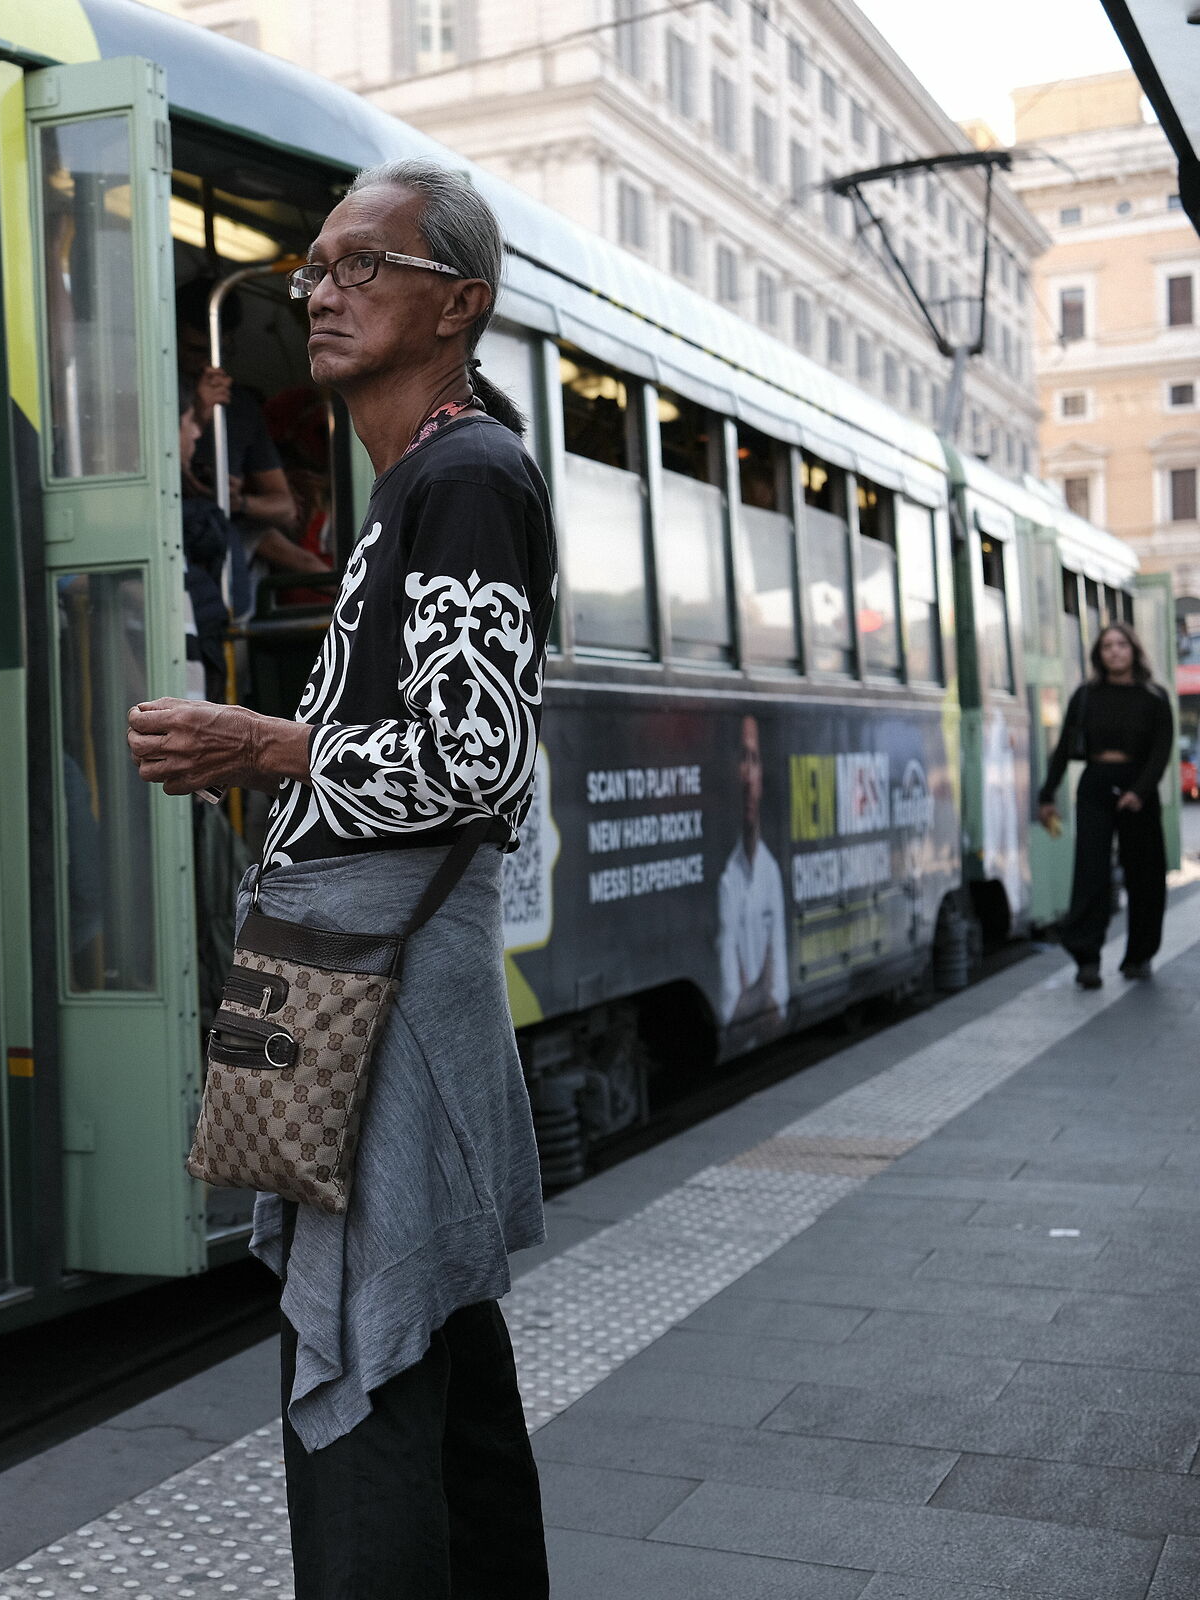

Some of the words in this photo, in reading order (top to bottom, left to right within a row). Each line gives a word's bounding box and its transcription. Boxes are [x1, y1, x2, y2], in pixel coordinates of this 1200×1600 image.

[587, 770, 626, 803] SCAN
[627, 768, 645, 800] TO
[646, 767, 677, 798] PLAY
[677, 764, 701, 795] THE
[789, 753, 836, 842] NEW
[588, 818, 621, 853] NEW
[622, 814, 659, 849] HARD
[660, 811, 693, 843] ROCK
[694, 810, 703, 839] X
[589, 865, 631, 904] MESSI
[632, 853, 704, 895] EXPERIENCE
